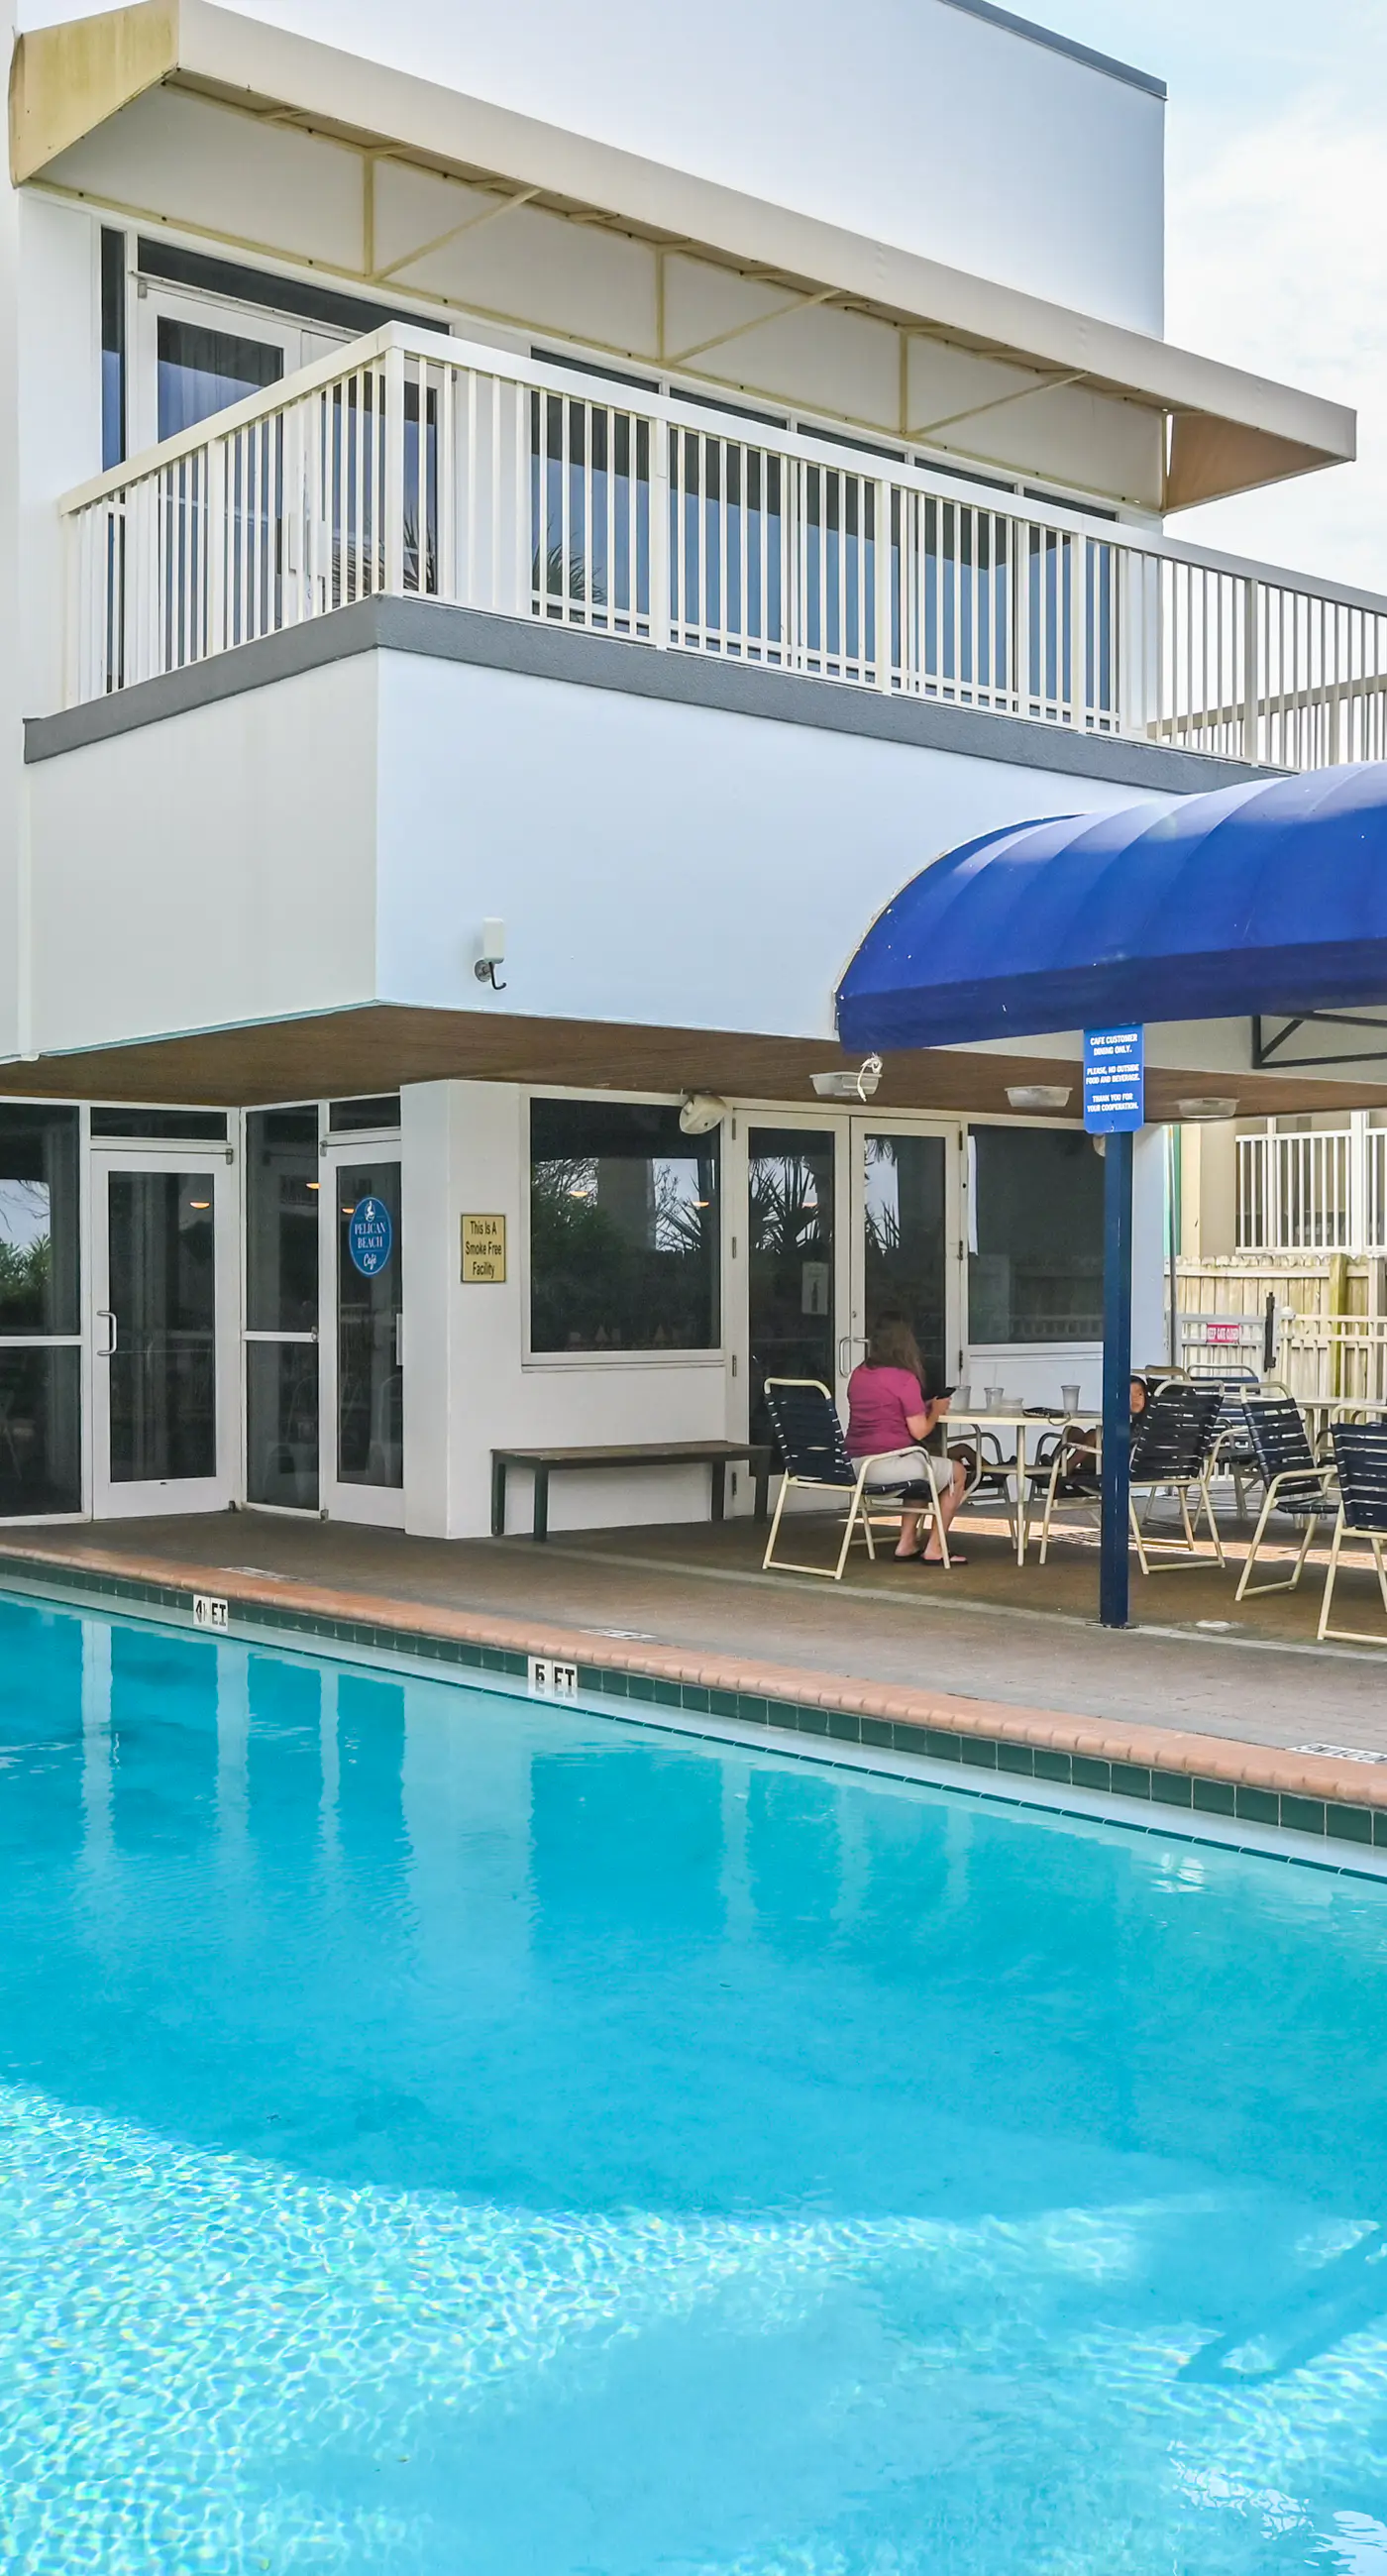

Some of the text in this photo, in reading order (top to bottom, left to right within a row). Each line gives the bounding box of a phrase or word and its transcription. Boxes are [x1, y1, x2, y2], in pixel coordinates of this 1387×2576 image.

[1090, 1033, 1137, 1045] CAFE CUSTOMER
[1094, 1044, 1132, 1056] DINING ONLY.
[1087, 1066, 1108, 1075] PLEASE,
[1117, 1063, 1139, 1073] OUTSIDE
[1086, 1076, 1100, 1085] FOOD
[1100, 1075, 1111, 1084] AND
[1092, 1094, 1110, 1103] THANK
[1111, 1093, 1121, 1102] YOU
[1087, 1102, 1139, 1113] YOUR COOPERATION.
[354, 1222, 386, 1234] PELICAN
[470, 1220, 497, 1234] This Is A
[358, 1235, 382, 1248] BEACH
[466, 1240, 502, 1255] Smoke Free
[473, 1261, 494, 1279] Facility
[554, 1666, 575, 1686] FT
